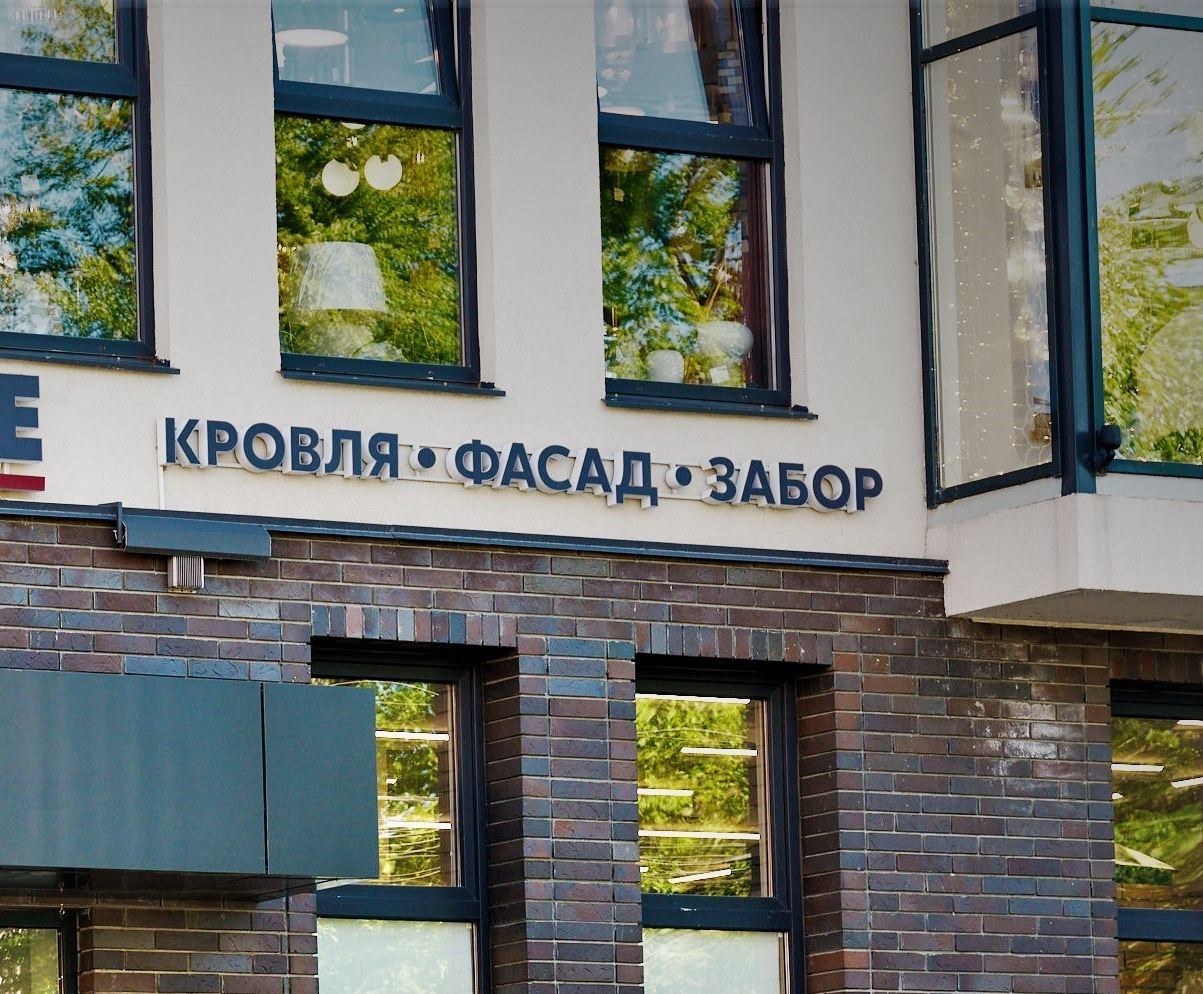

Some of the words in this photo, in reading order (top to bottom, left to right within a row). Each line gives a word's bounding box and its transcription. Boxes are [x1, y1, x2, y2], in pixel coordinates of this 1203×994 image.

[164, 417, 399, 479] КРОВЛЯ
[452, 438, 659, 508] ФАСАД
[704, 456, 884, 513] ЗАБОР
